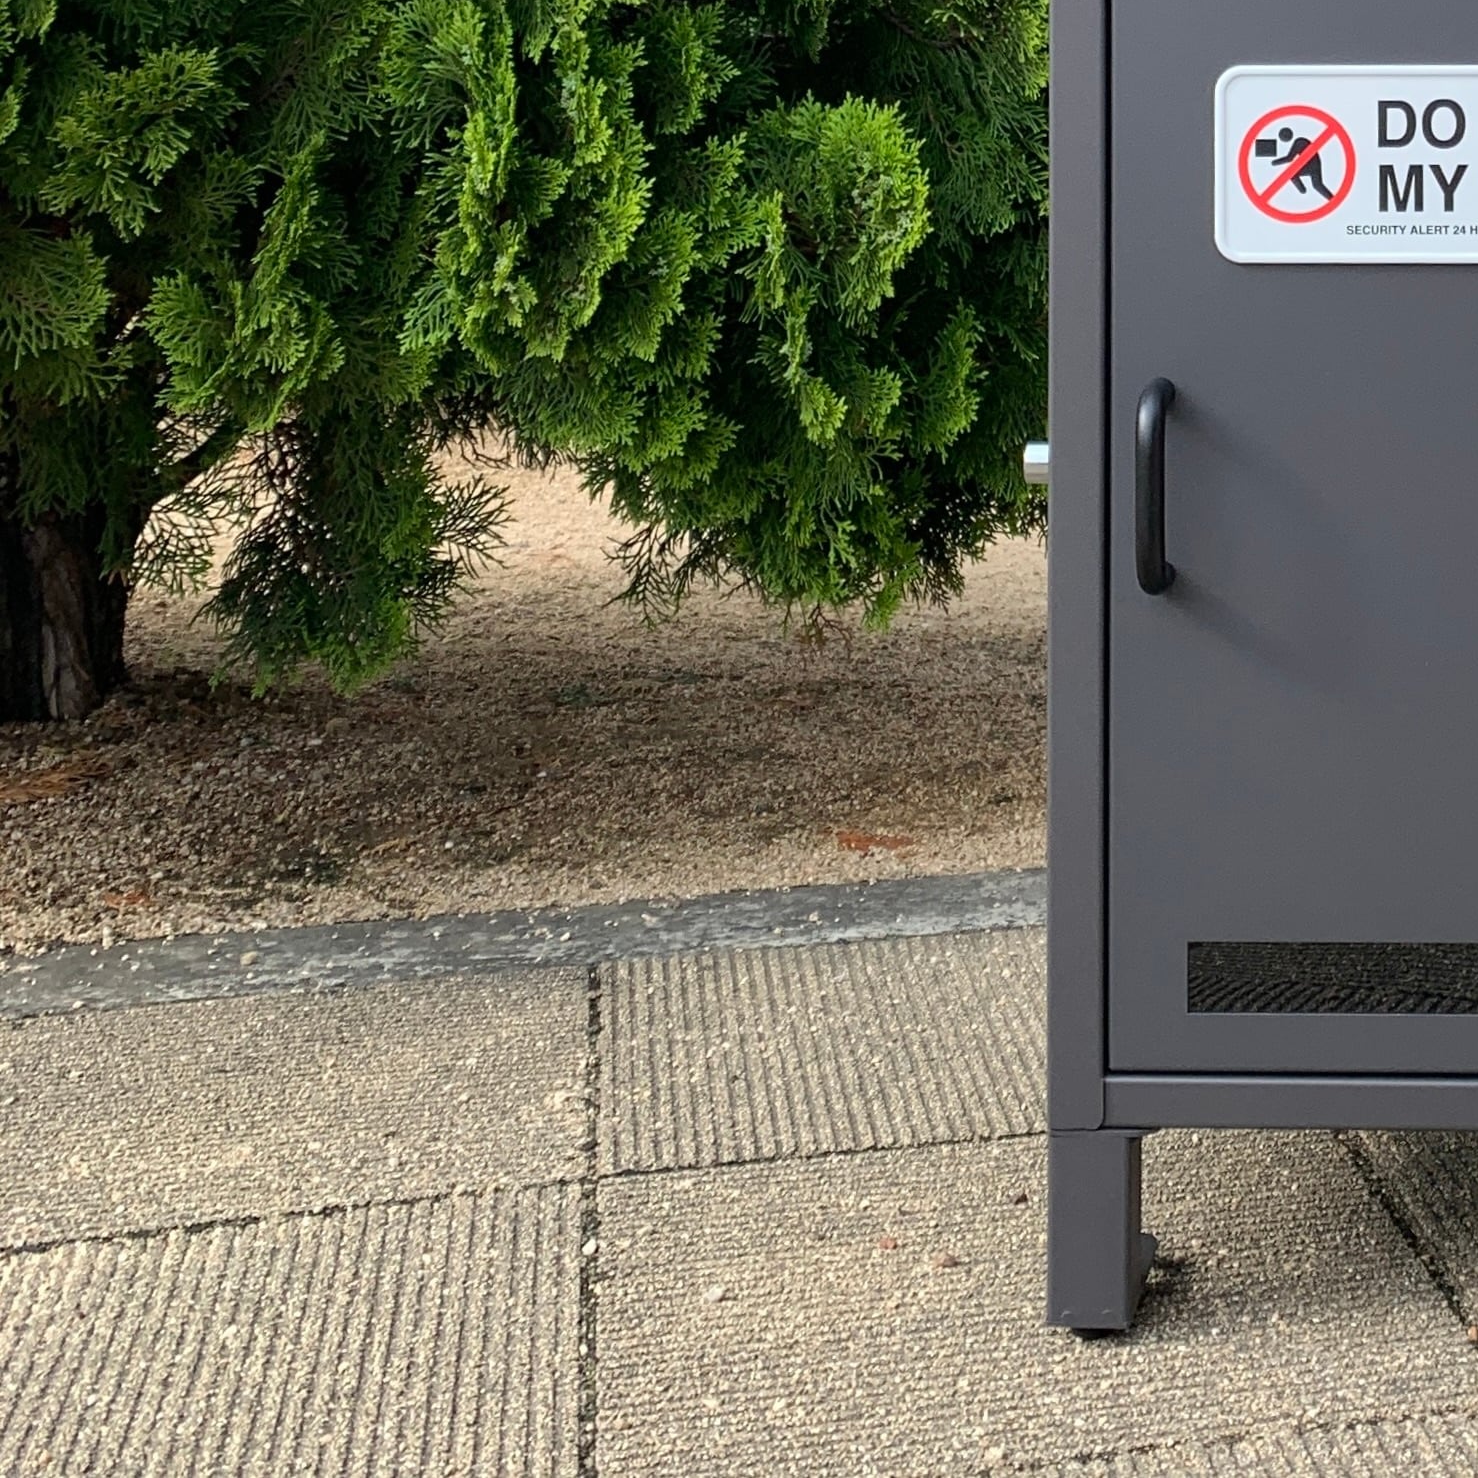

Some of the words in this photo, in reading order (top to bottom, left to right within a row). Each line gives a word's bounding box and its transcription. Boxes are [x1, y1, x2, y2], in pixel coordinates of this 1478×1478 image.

[1377, 99, 1466, 149] DO
[1379, 165, 1469, 212] MY
[1346, 225, 1407, 236] SECURITY
[1410, 225, 1450, 236] ALERT
[1453, 225, 1466, 236] 24
